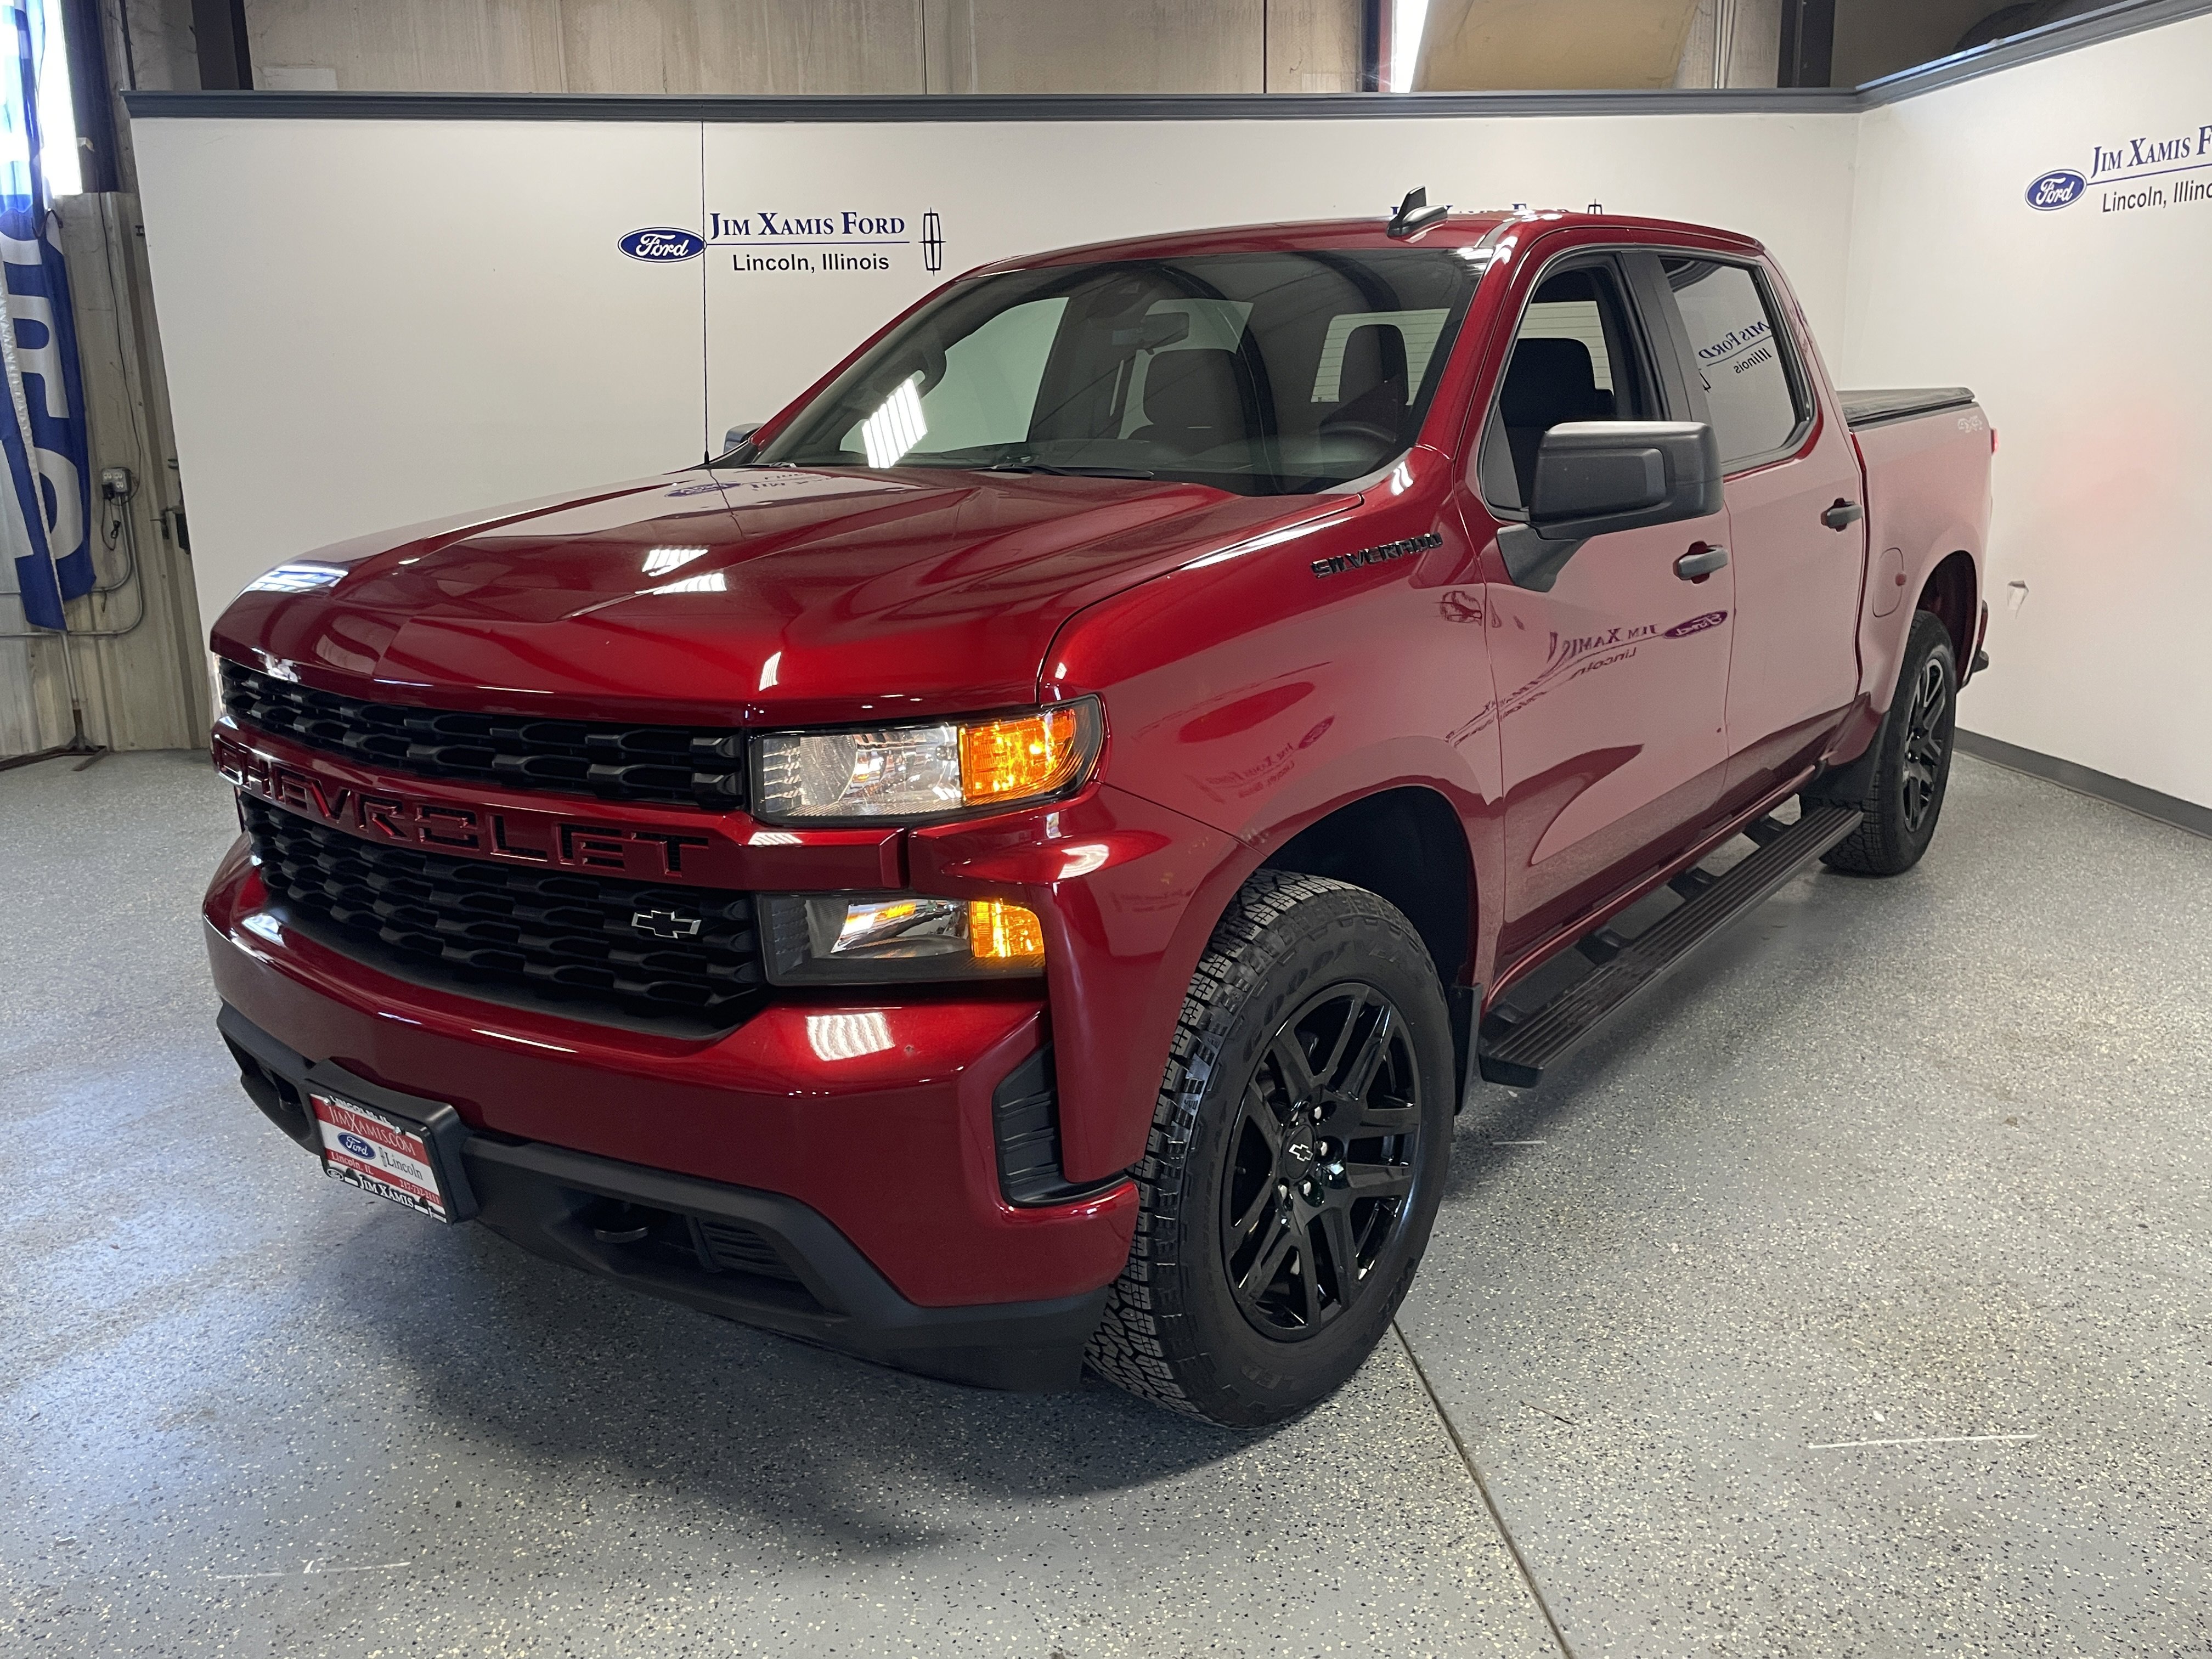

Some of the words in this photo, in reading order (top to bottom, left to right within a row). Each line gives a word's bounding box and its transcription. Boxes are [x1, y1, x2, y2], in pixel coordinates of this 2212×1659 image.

[2091, 146, 2123, 179] JIM
[2126, 137, 2191, 167] XAMIS
[2102, 186, 2166, 213] Lincoln,
[710, 212, 751, 240] JIM
[757, 212, 834, 235] XAMIS
[841, 211, 905, 235] FORD
[635, 234, 689, 257] Ford
[733, 253, 815, 274] Lincoln,
[823, 253, 889, 270] Illinois
[1310, 531, 1444, 579] SILVERADO
[215, 733, 710, 878] CHEVROLET
[346, 1135, 368, 1156] Ford
[385, 1152, 424, 1181] Lincoln
[377, 1184, 414, 1208] XAMIS
